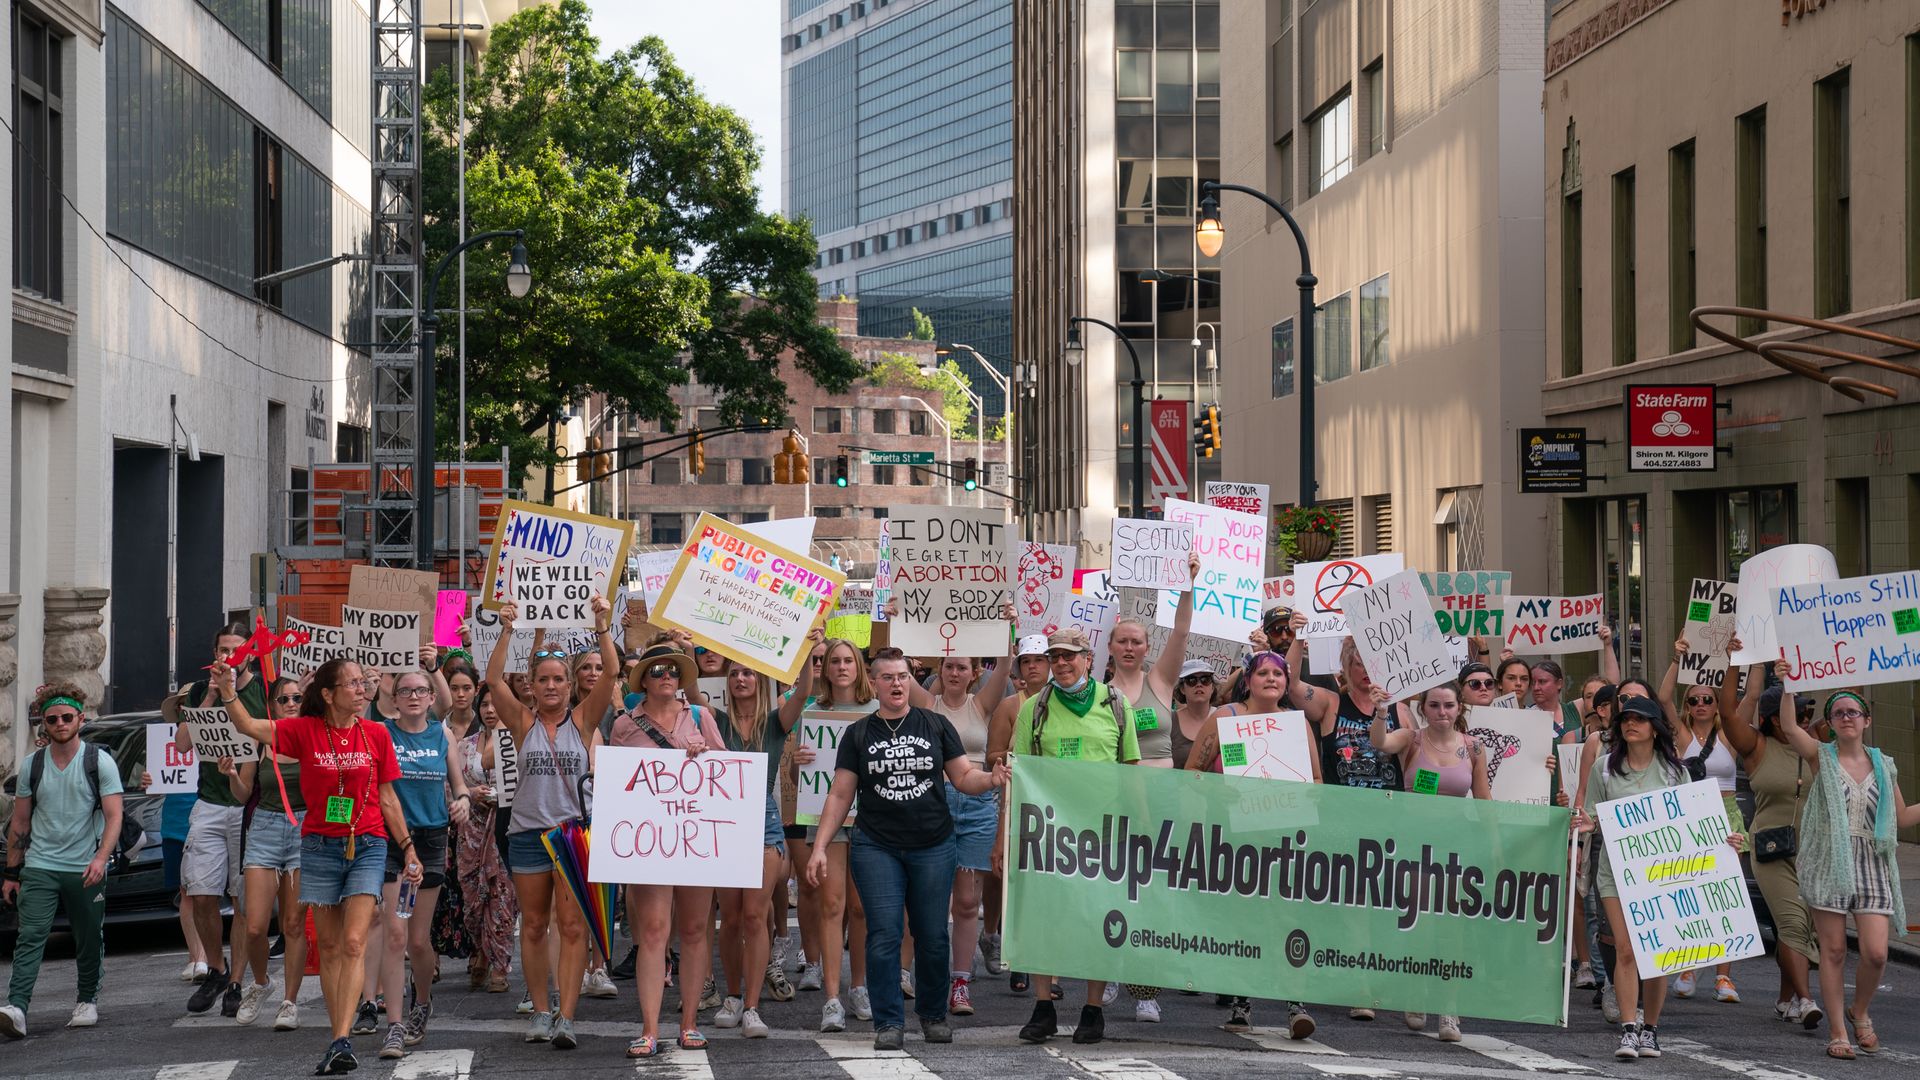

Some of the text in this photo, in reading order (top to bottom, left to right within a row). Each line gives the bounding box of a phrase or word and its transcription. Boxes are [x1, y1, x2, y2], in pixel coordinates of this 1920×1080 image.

[1159, 419, 1179, 428] DTN
[870, 453, 900, 463] Marietta
[902, 453, 911, 463] St
[1543, 443, 1575, 452] IMPRINT
[1678, 451, 1708, 459] Kilgore
[1208, 485, 1258, 496] KEEP YOUR
[510, 514, 614, 558] MIND YOUR
[891, 520, 915, 540] I
[1117, 525, 1191, 552] SCOTUS
[1224, 517, 1263, 542] YOUR
[580, 550, 612, 568] OWN
[701, 524, 838, 598] PUBLIC CERVIX
[892, 547, 1003, 564] REGRET MY
[1192, 534, 1261, 567] HURCH
[367, 570, 422, 593] HANDS
[516, 566, 593, 581] WE WILL
[684, 542, 831, 616] ANNOUNCEMENT
[894, 565, 1007, 583] ABORTION
[1204, 570, 1259, 592] OF MY
[446, 591, 463, 605] GO
[518, 585, 590, 600] NOT GO
[699, 569, 801, 622] THE HARDEST DECISION
[704, 588, 711, 597] A
[718, 591, 755, 615] WOMAN
[903, 588, 1004, 606] MY BODY
[1364, 583, 1391, 620] MY
[1693, 580, 1726, 601] MY
[1778, 573, 1918, 615] Abortions Still
[526, 604, 586, 620] BACK
[1070, 600, 1108, 624] GET
[1168, 586, 1261, 623] STATE
[1442, 594, 1486, 610] THE
[1516, 597, 1603, 619] MY BODY
[343, 607, 419, 629] MY BODY
[904, 605, 1005, 623] MY CHOICE
[1434, 609, 1504, 636] OURT
[1822, 610, 1886, 638] Happen
[359, 629, 384, 648] MY
[1364, 610, 1412, 652] BODY
[1507, 621, 1599, 646] MY CHOICE
[346, 647, 415, 667] CHOICE
[1385, 641, 1410, 673] MY
[1681, 652, 1710, 670] MY
[1868, 642, 1920, 671] Abortio
[183, 709, 215, 725] BANS
[1236, 717, 1283, 738] HER
[200, 728, 232, 742] OUR
[803, 725, 843, 749] MY
[868, 735, 932, 755] OUR BODIES
[195, 742, 253, 758] BODIES
[884, 747, 916, 758] OUR
[867, 756, 934, 774] FUTURES
[161, 769, 187, 784] WE
[624, 758, 752, 800] ABORT
[887, 774, 917, 788] OUR
[874, 778, 934, 800] ABORTIONS
[660, 799, 703, 816] THE
[1662, 790, 1685, 820] BE
[611, 818, 737, 859] COURT
[1614, 815, 1729, 862] TRUSTED WITH
[1018, 802, 1560, 943] RiseUp4AbortionRights.org
[1623, 868, 1637, 886] A
[1629, 876, 1746, 926] BUT YOU TRUST
[1130, 928, 1261, 959] @RiseUp4Abortion
[1638, 915, 1734, 953] ME WITH A
[1313, 947, 1473, 981] @Rise4AbortionRights
